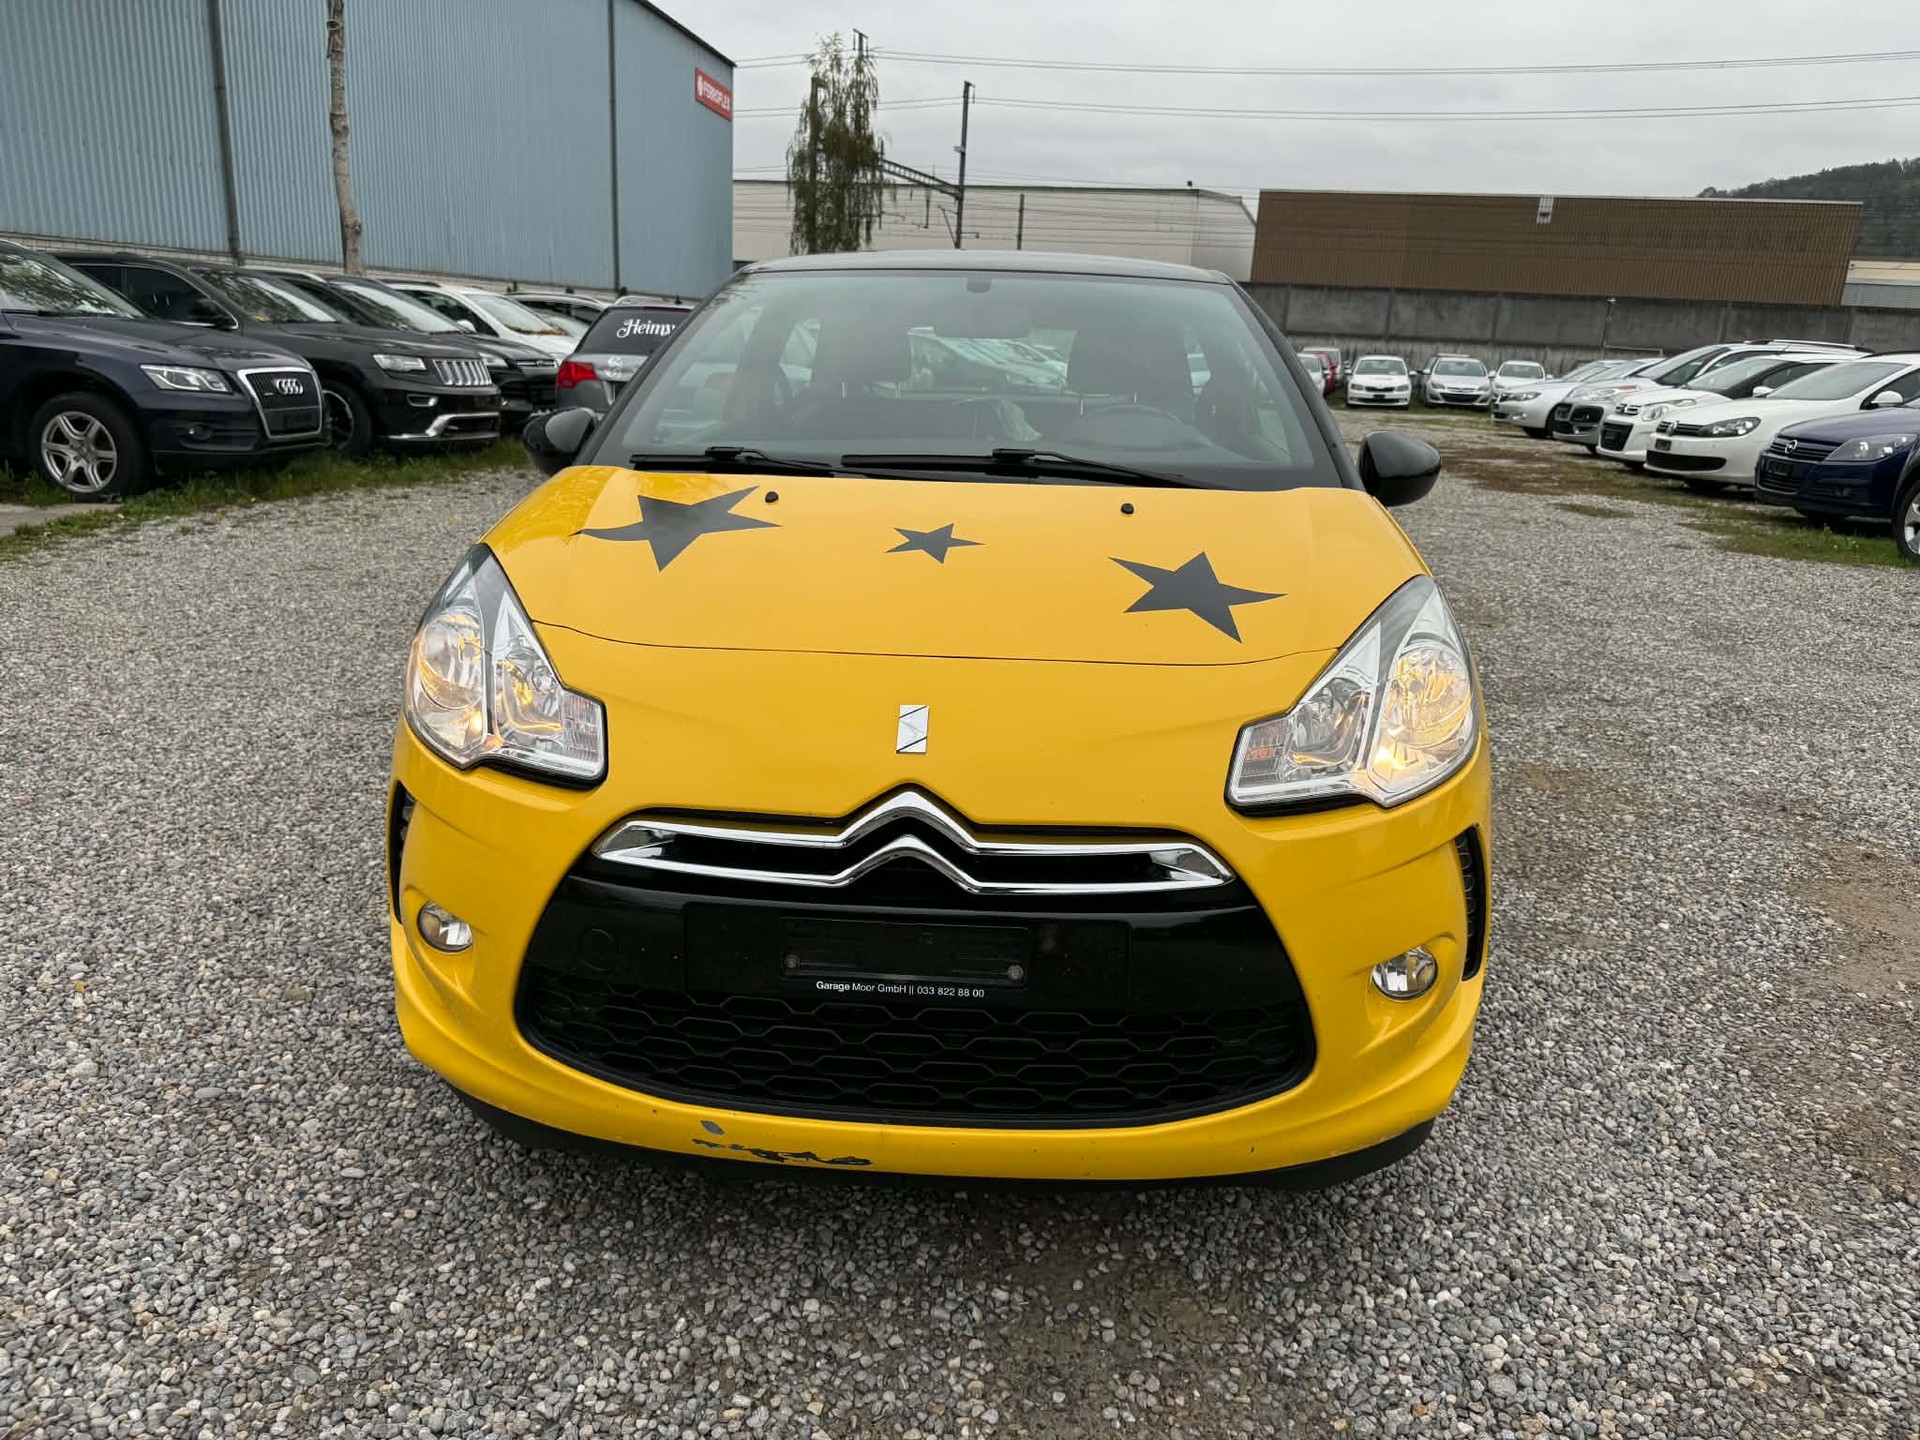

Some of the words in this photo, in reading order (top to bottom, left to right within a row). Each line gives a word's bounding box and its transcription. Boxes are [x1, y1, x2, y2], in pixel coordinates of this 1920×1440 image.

[815, 980, 851, 992] Garage
[852, 982, 876, 992] Moor
[877, 983, 907, 993] GmbH
[917, 986, 935, 995] 033
[937, 987, 955, 996] 822
[957, 988, 970, 997] 88
[972, 989, 985, 998] 00
